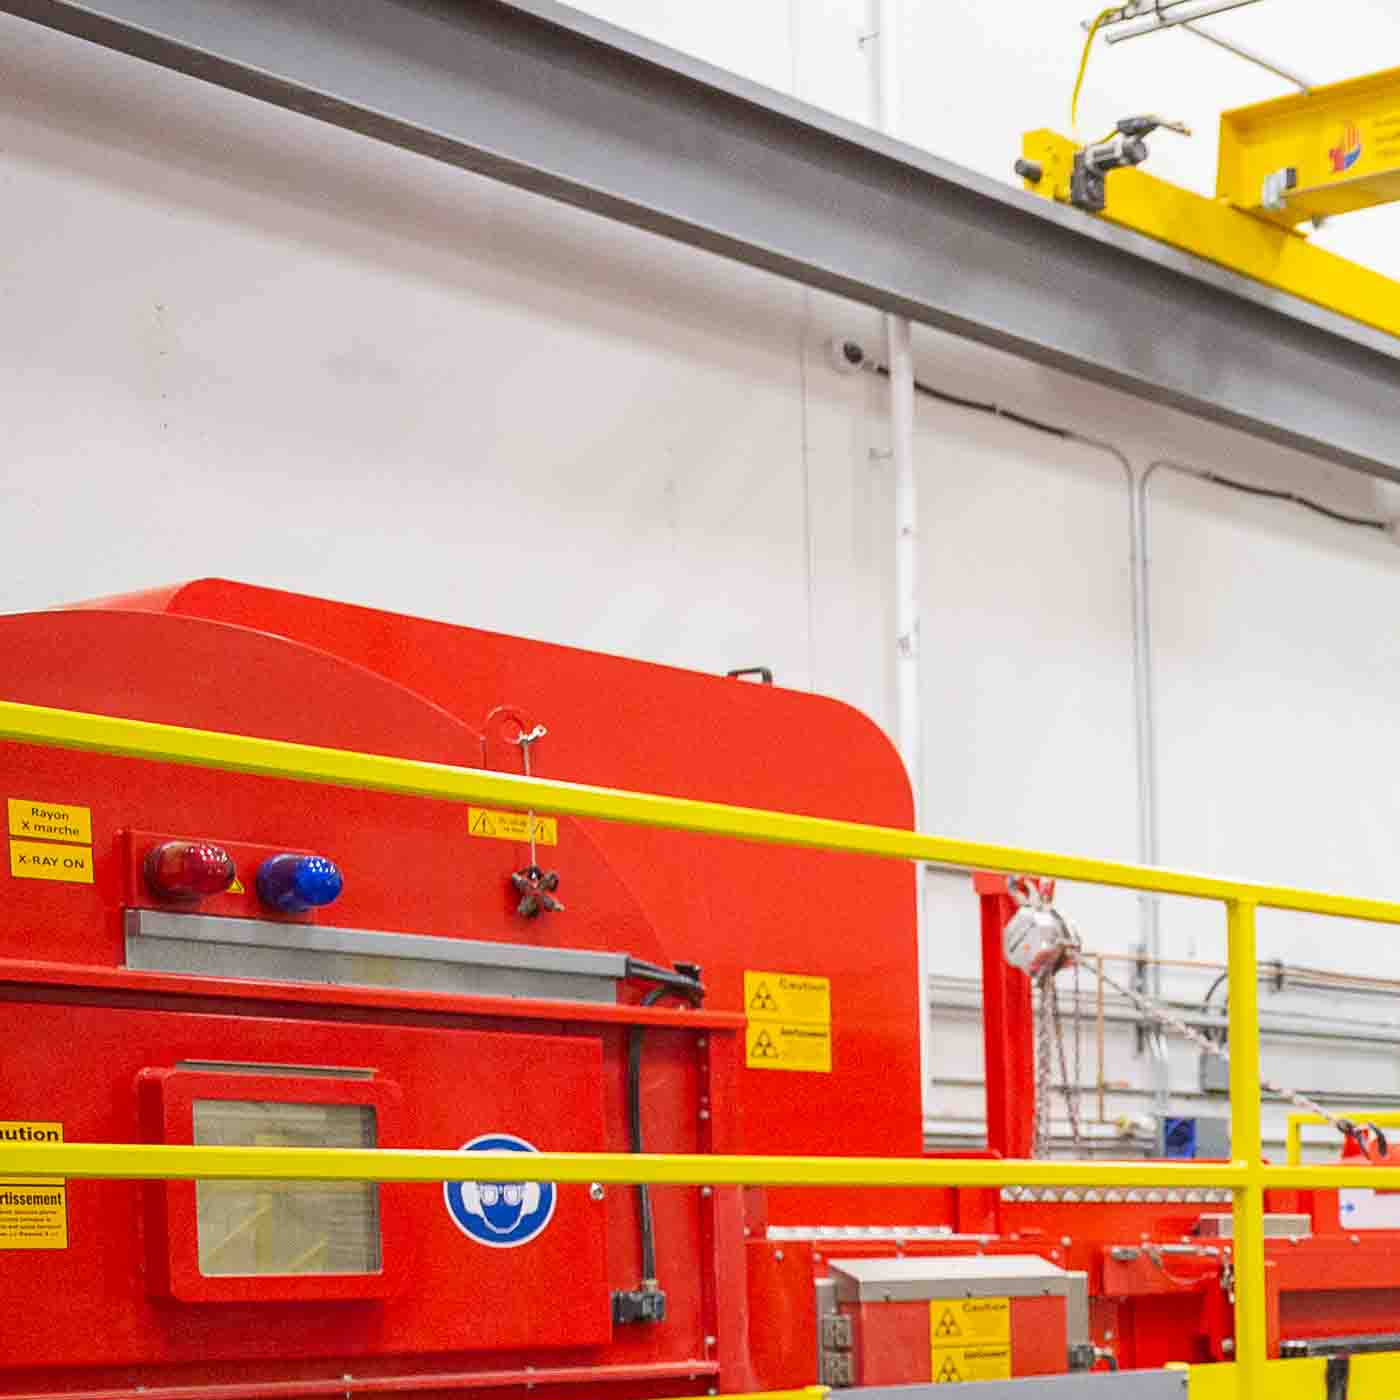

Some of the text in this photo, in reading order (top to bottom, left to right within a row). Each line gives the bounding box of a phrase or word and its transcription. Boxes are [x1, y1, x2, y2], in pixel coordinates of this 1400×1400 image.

[31, 807, 70, 821] Rayon
[21, 820, 80, 836] X marche
[18, 855, 85, 869] X-RAY ON
